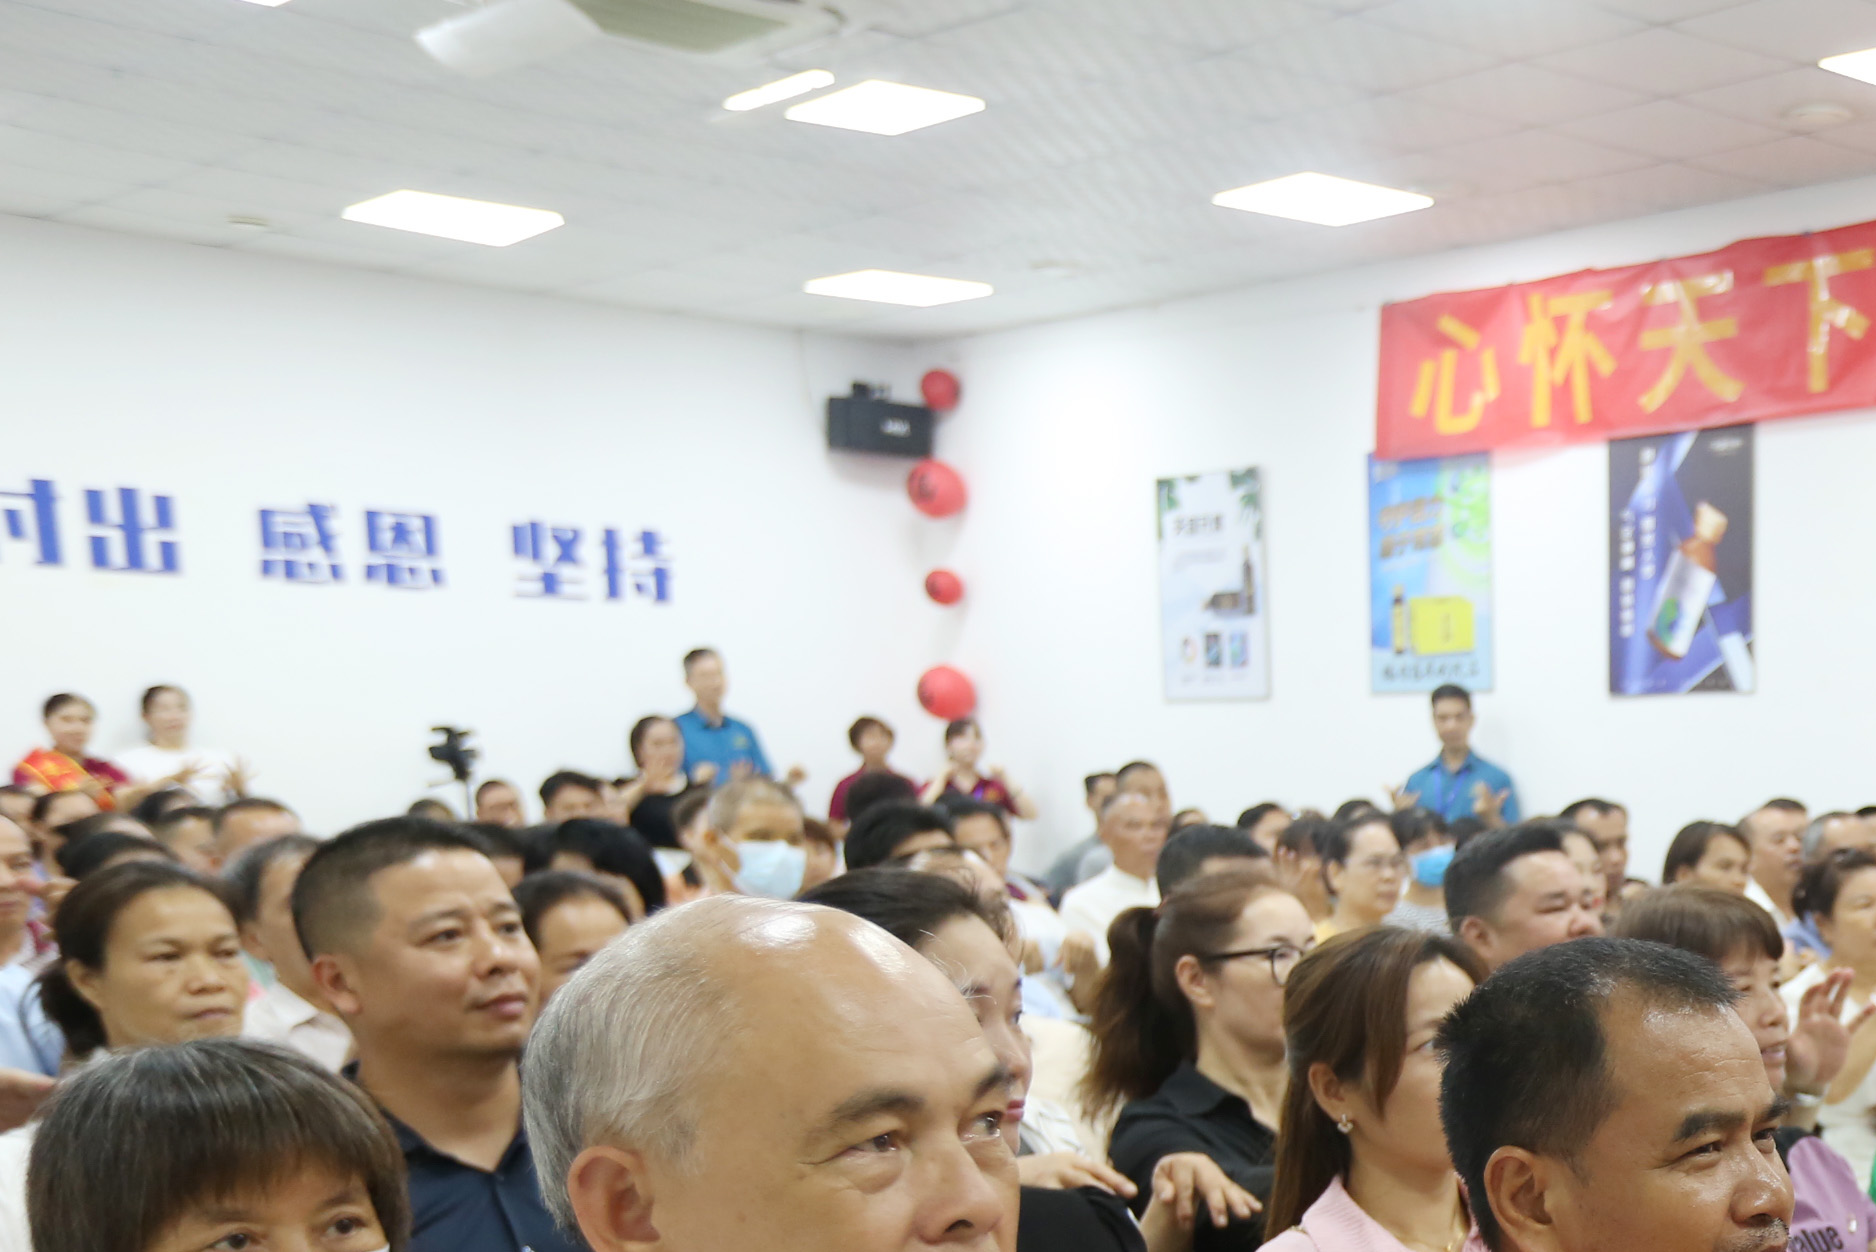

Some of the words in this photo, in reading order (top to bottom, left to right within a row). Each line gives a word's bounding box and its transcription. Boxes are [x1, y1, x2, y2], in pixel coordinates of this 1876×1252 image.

[1408, 248, 1876, 436] 心怀天下
[258, 503, 445, 589] 感恩
[511, 522, 671, 603] 坚持
